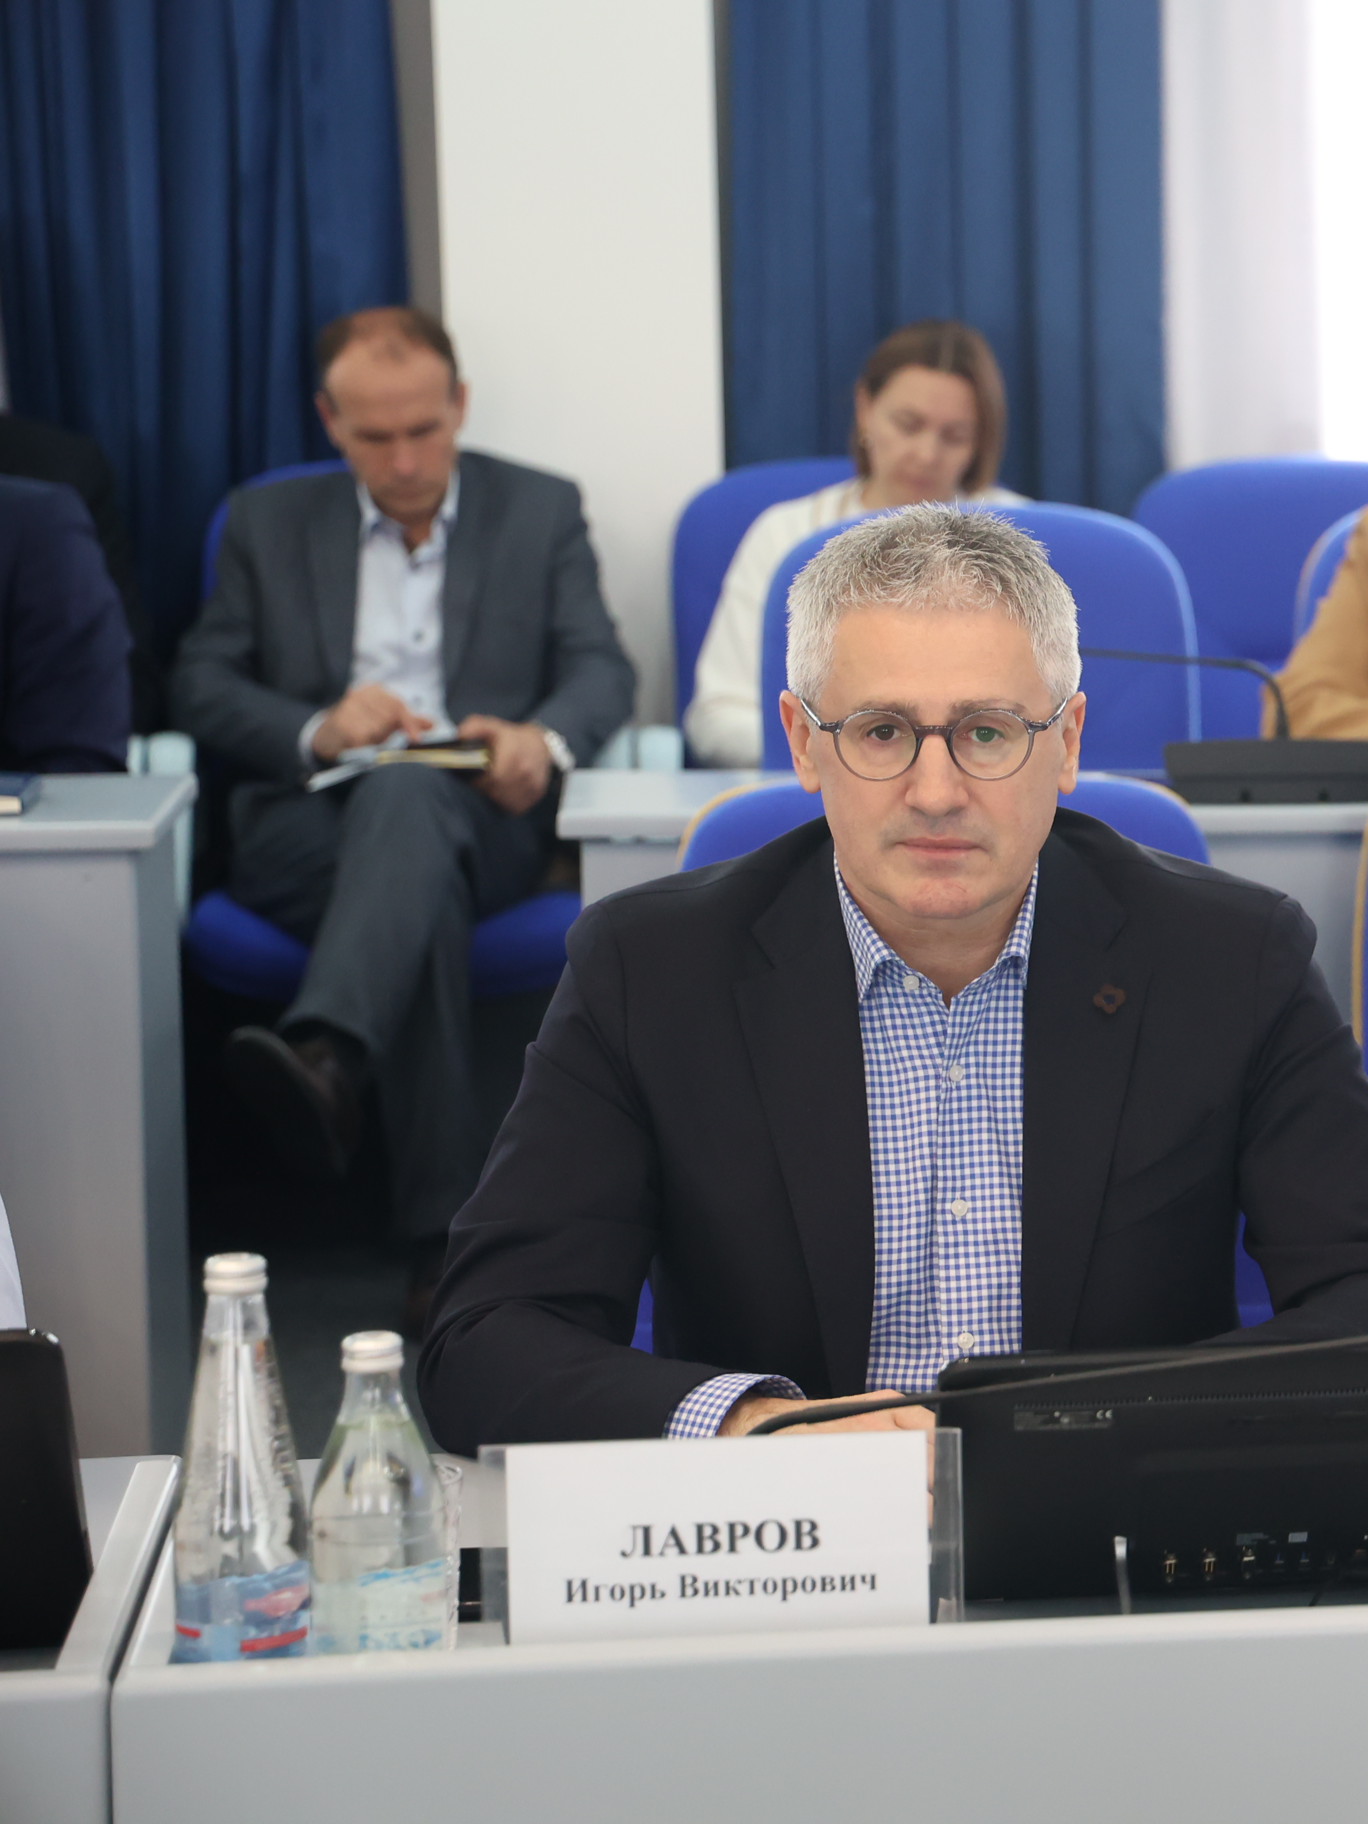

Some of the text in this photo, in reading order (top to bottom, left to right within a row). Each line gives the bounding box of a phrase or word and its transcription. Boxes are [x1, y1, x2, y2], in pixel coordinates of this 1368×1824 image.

[620, 1518, 821, 1558] ЛАВРОВ
[564, 1572, 877, 1608] Игорь Викторович
